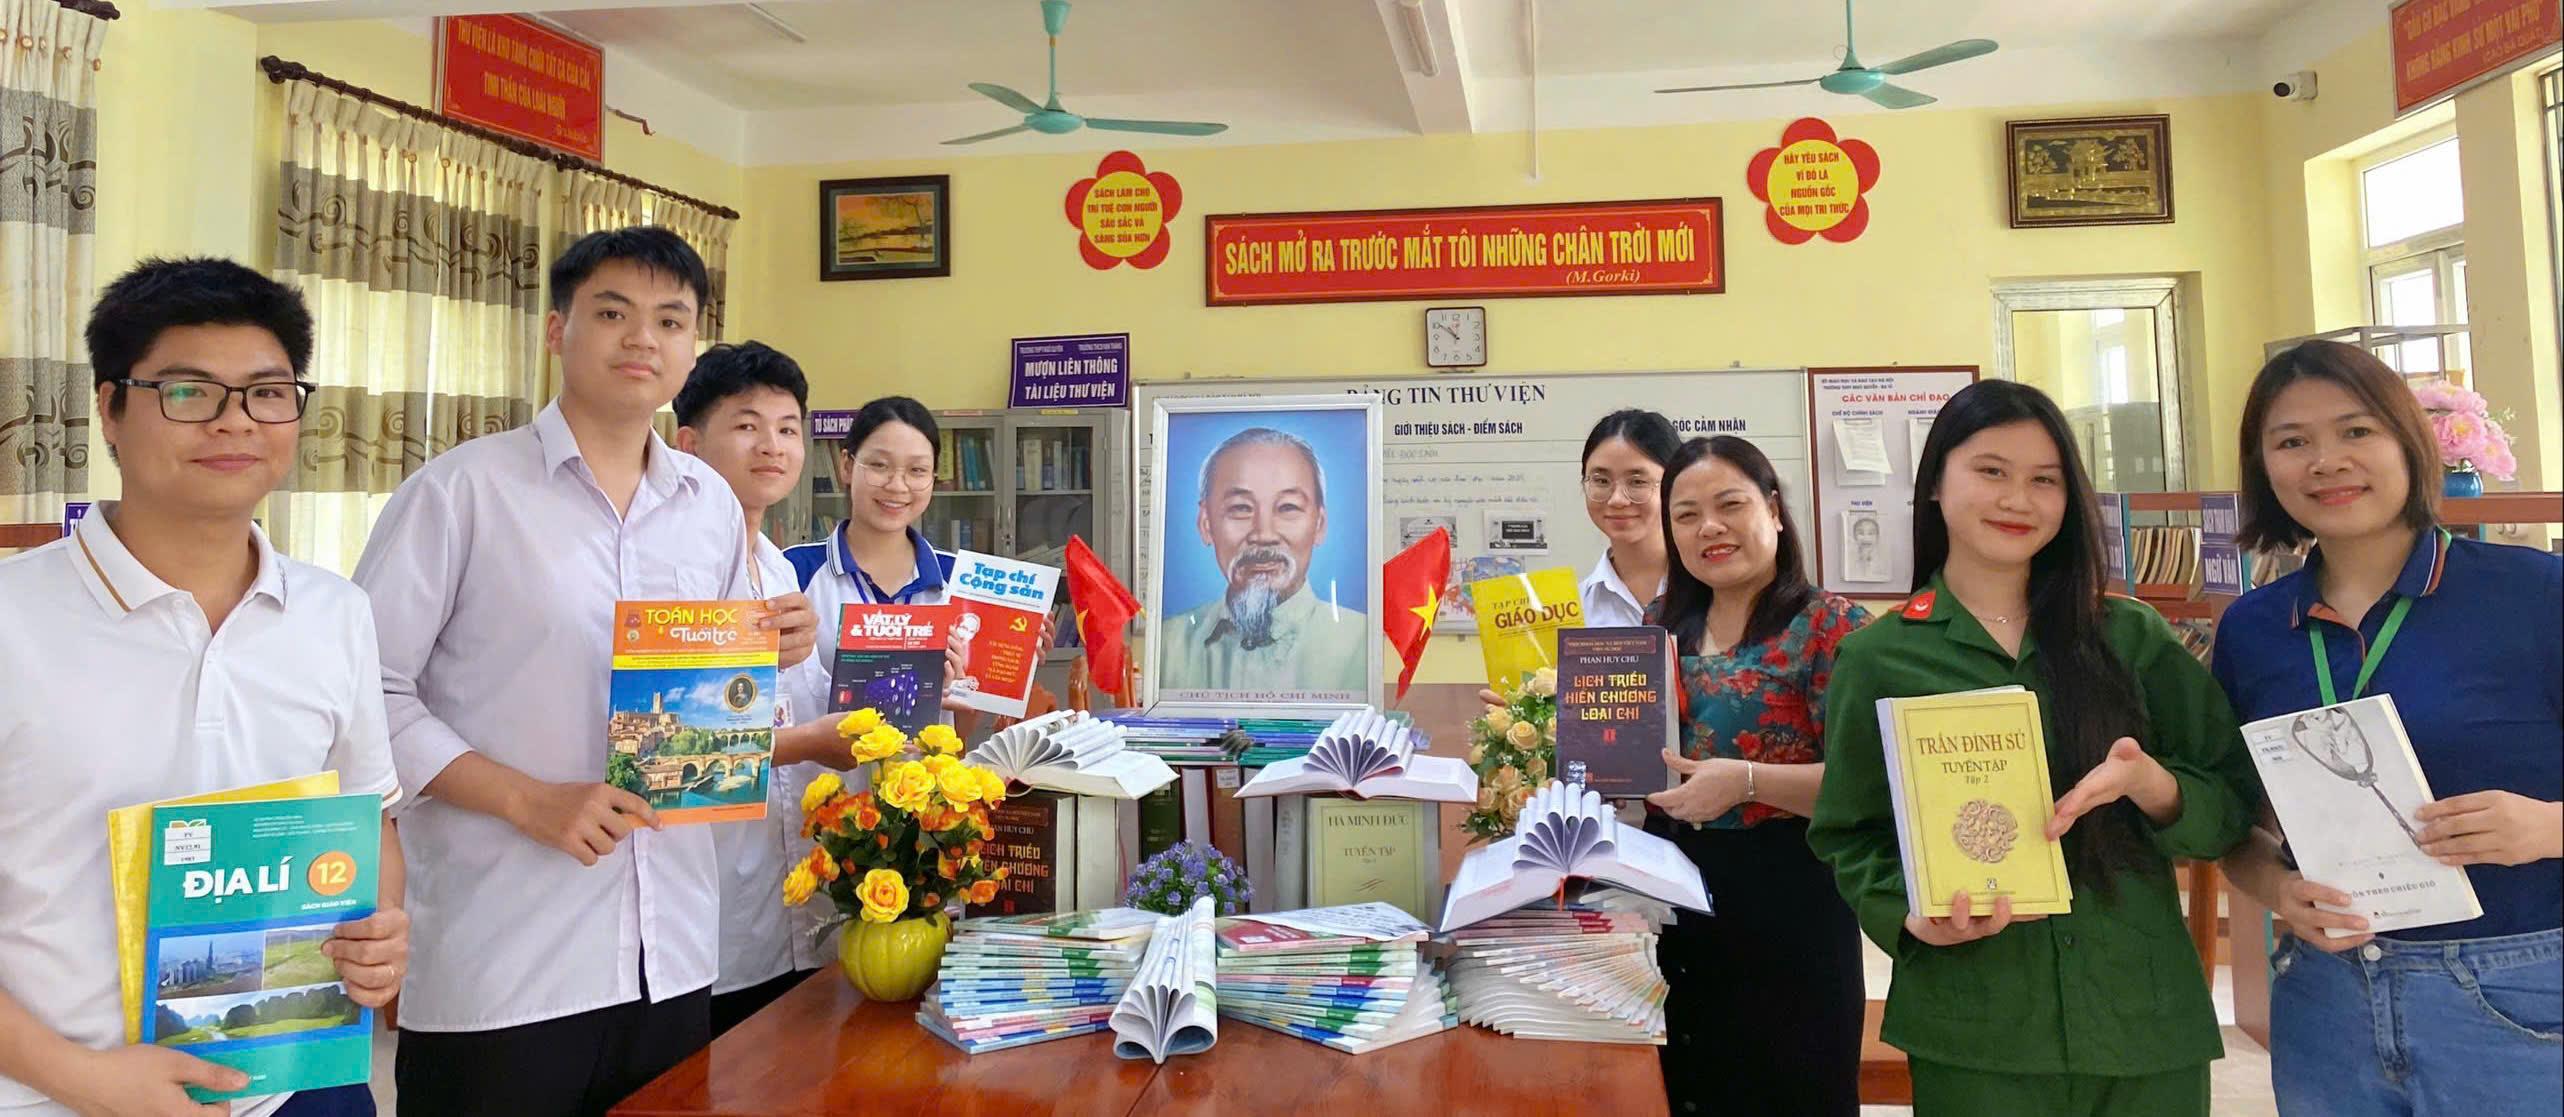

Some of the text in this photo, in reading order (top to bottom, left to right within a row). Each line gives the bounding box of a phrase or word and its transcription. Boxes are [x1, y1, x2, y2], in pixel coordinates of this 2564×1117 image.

[1225, 222, 1695, 275] SÁCH MỞ RA TRƯỚC MẮT TÔI NHỮNG CHÂN TRỜI MỚI
[1566, 269, 1641, 286] (M.Gorki)
[1025, 356, 1118, 379] MƯỢN LIÊN THÔNG
[1025, 380, 1116, 402] TÀI LIỆU THƯ VIỆN
[1408, 381, 1545, 405] TIN THƯ VIỆN
[1842, 392, 1863, 403] CÁC
[1866, 392, 1885, 403] VĂN
[1888, 391, 1907, 402] BẢN
[1910, 391, 1926, 402] CHỈ
[1394, 420, 1412, 436] GIỚI
[1415, 420, 1439, 438] THIỆU
[1442, 420, 1465, 435] SÁCH
[1474, 418, 1497, 434] ĐIỂM
[1499, 419, 1523, 434] SÁCH
[1695, 416, 1716, 432] CẢM
[1718, 416, 1746, 435] NHẬN
[974, 562, 1036, 586] Tạp chí
[2205, 554, 2237, 584] NGỮ VĂN
[960, 574, 1007, 596] Cộng
[1010, 582, 1044, 600] sản
[645, 606, 694, 625] TOÁN
[700, 608, 738, 626] HỌC
[1495, 602, 1579, 629] GIÁO DỤC
[851, 620, 934, 637] & TUỔI TRẺ
[1580, 656, 1601, 664] PHAN
[1574, 671, 1647, 689] LỊCH TRIỀU
[1180, 690, 1350, 700] CHỦ TỊCH HỒ CHÍ MINH
[1566, 689, 1657, 704] HIẾN CHƯƠNG
[1582, 706, 1640, 722] LOẠI CHÍ
[1916, 728, 2027, 755] TRẦN ĐÌNH SỬ
[1940, 758, 2008, 774] TUYỂN TẬP
[1964, 774, 1989, 785] Tập 2
[1348, 816, 1380, 826] MINH
[1008, 844, 1040, 860] TRIỀU
[182, 856, 348, 904] ĐỊA LÍ 12
[302, 902, 320, 910] SÁCH
[322, 900, 339, 908] GIÁO
